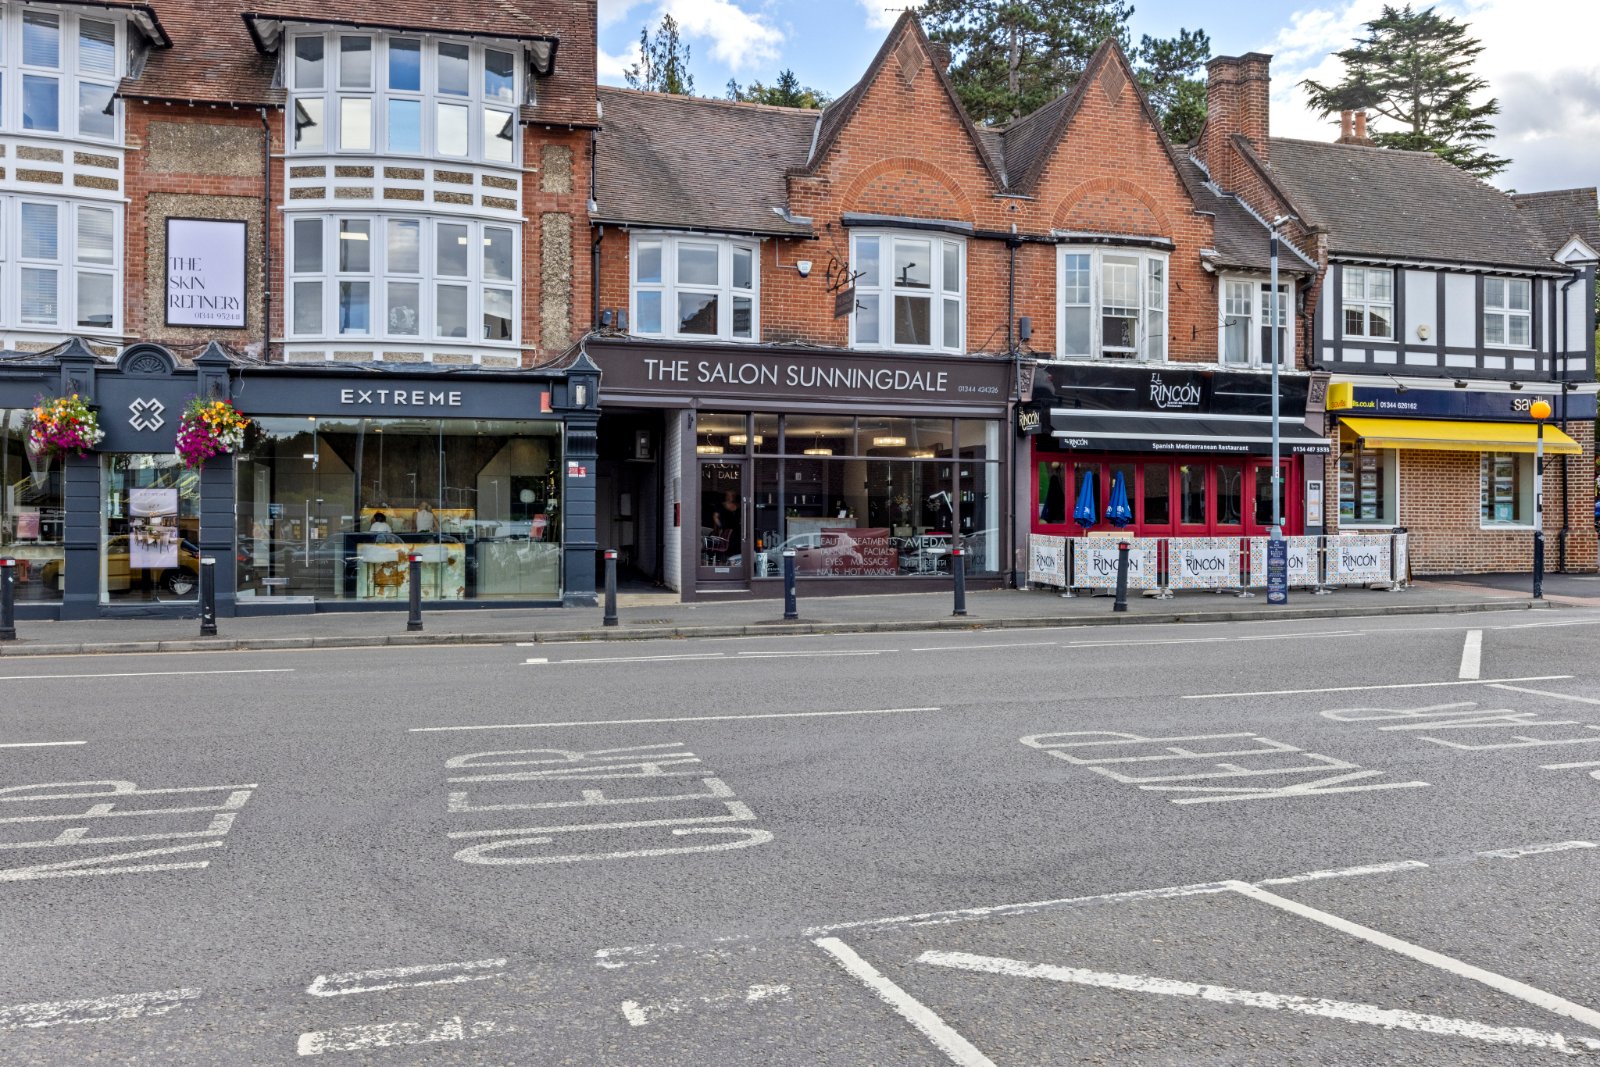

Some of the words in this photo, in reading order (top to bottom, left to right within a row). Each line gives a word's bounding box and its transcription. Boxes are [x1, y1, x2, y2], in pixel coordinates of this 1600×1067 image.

[169, 257, 202, 271] THE
[169, 276, 206, 290] SKIN
[169, 294, 240, 310] REFINERY
[643, 358, 689, 382] THE
[697, 361, 778, 386] SALON
[786, 364, 948, 392] SUNNINGDALE
[957, 385, 976, 393] 01344
[340, 388, 462, 406] EXTREME
[1149, 382, 1201, 409] RINCÓN
[1379, 401, 1397, 409] 01344
[1175, 443, 1218, 451] Mediterranean
[849, 537, 897, 546] TREATMENTS
[904, 537, 947, 548] AVEDA
[863, 547, 895, 556] FACIALS
[825, 558, 844, 566] EYES
[850, 558, 889, 566] MASSAGE
[1092, 558, 1139, 576] RINCN
[1185, 555, 1225, 576] RINCÓN
[1342, 552, 1377, 572] RINCÓN
[816, 568, 840, 576] NAILS
[844, 568, 861, 576] HOT
[863, 568, 896, 576] WAXING
